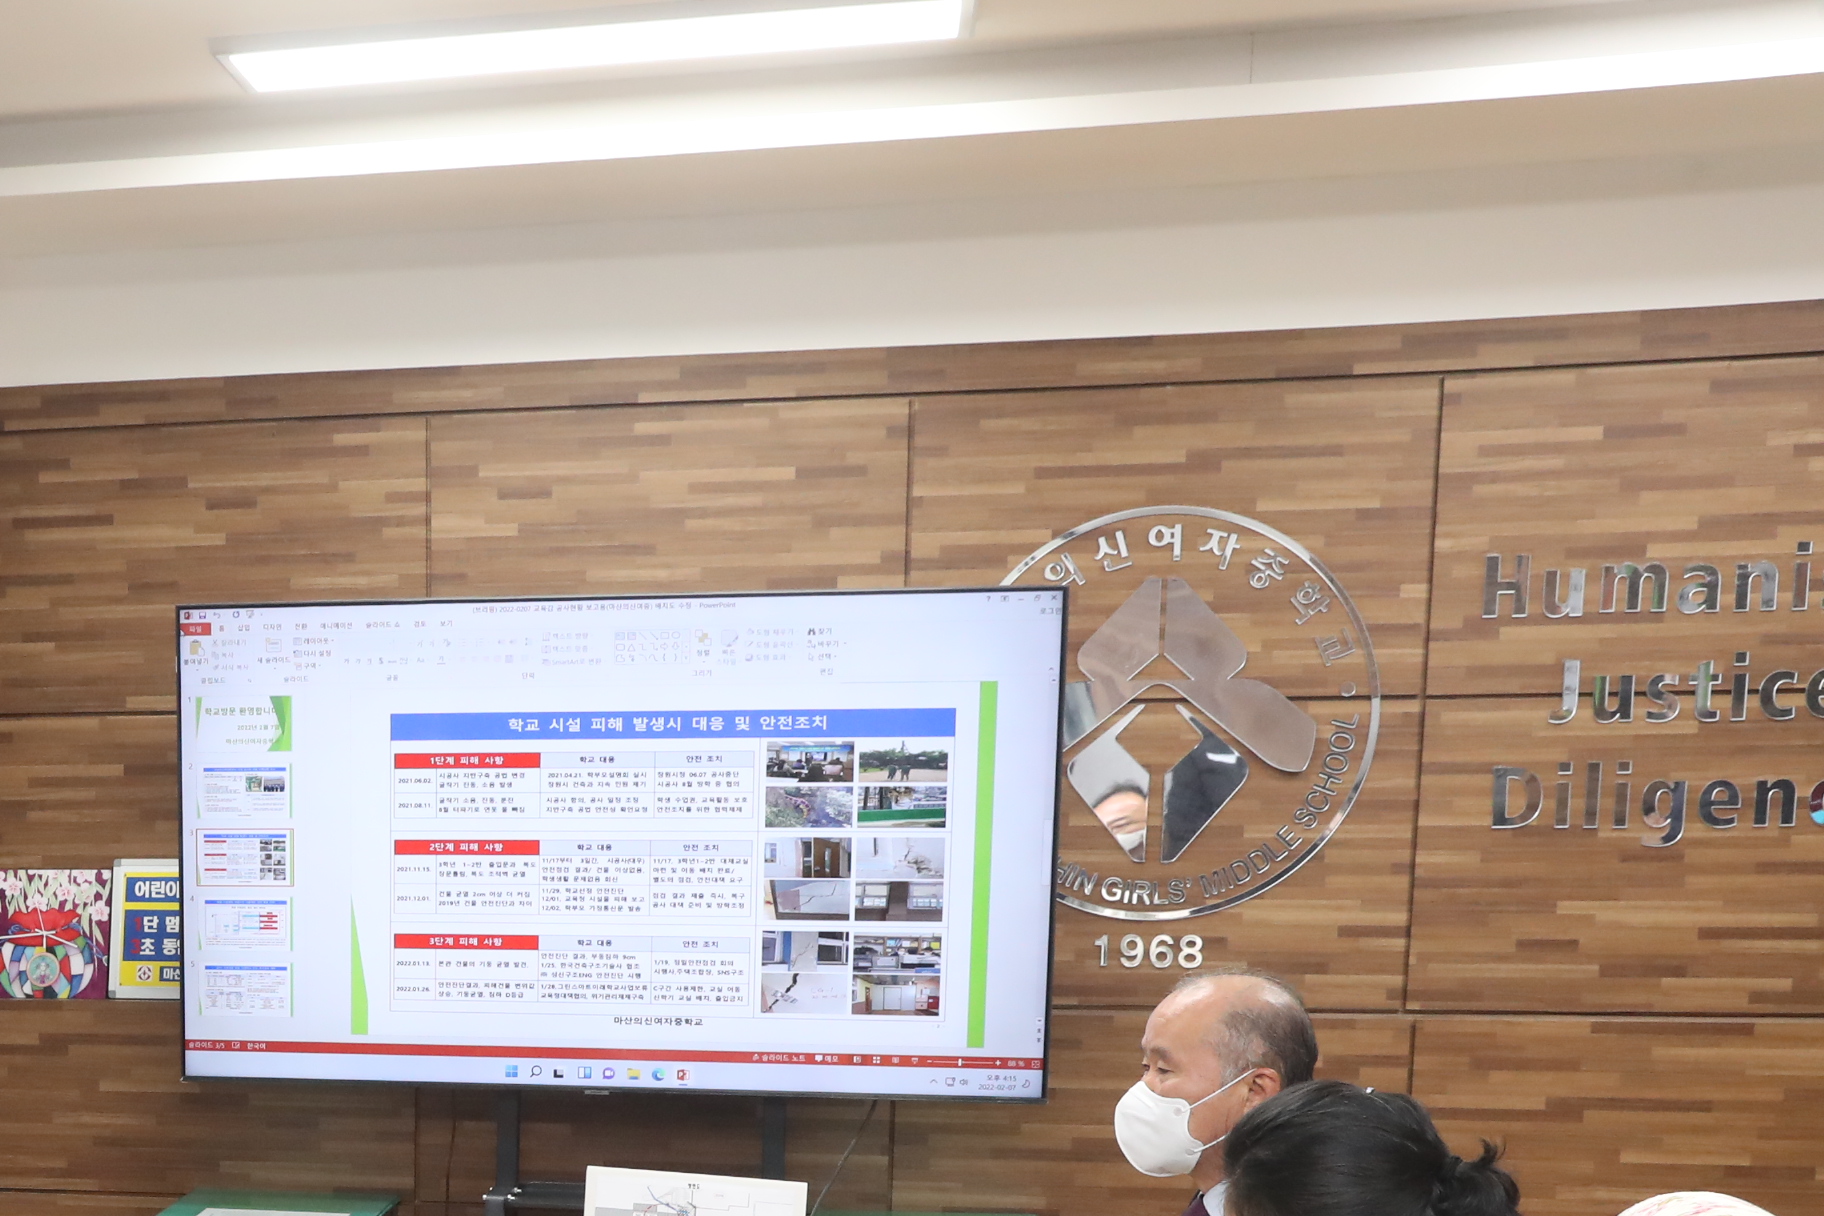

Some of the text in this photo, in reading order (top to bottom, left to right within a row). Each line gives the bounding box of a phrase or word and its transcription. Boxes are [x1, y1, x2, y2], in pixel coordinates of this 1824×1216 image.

[1482, 541, 1824, 618] Humani
[700, 601, 735, 609] PowerPoint
[508, 715, 826, 732] 학교 시설 피해 발생시 대응 및 안전조치
[430, 756, 503, 765] 1단계 피해 사항
[600, 756, 614, 764] 대응
[686, 755, 722, 763] 안전 조치
[1199, 825, 1303, 898] MIDDLE
[1293, 713, 1360, 830] SCHOOL
[430, 842, 503, 852] 2단계 피해 사항
[683, 844, 718, 852] 안전 조치
[134, 915, 159, 933] 1단
[129, 938, 156, 956] 3초
[430, 937, 502, 947] 3단계 피해 사항
[597, 939, 612, 947] 대응
[683, 940, 698, 948] 안전
[1094, 934, 1204, 968] 1968
[614, 1016, 703, 1026] 마산의신여자중학교
[987, 1074, 1000, 1082] 오후
